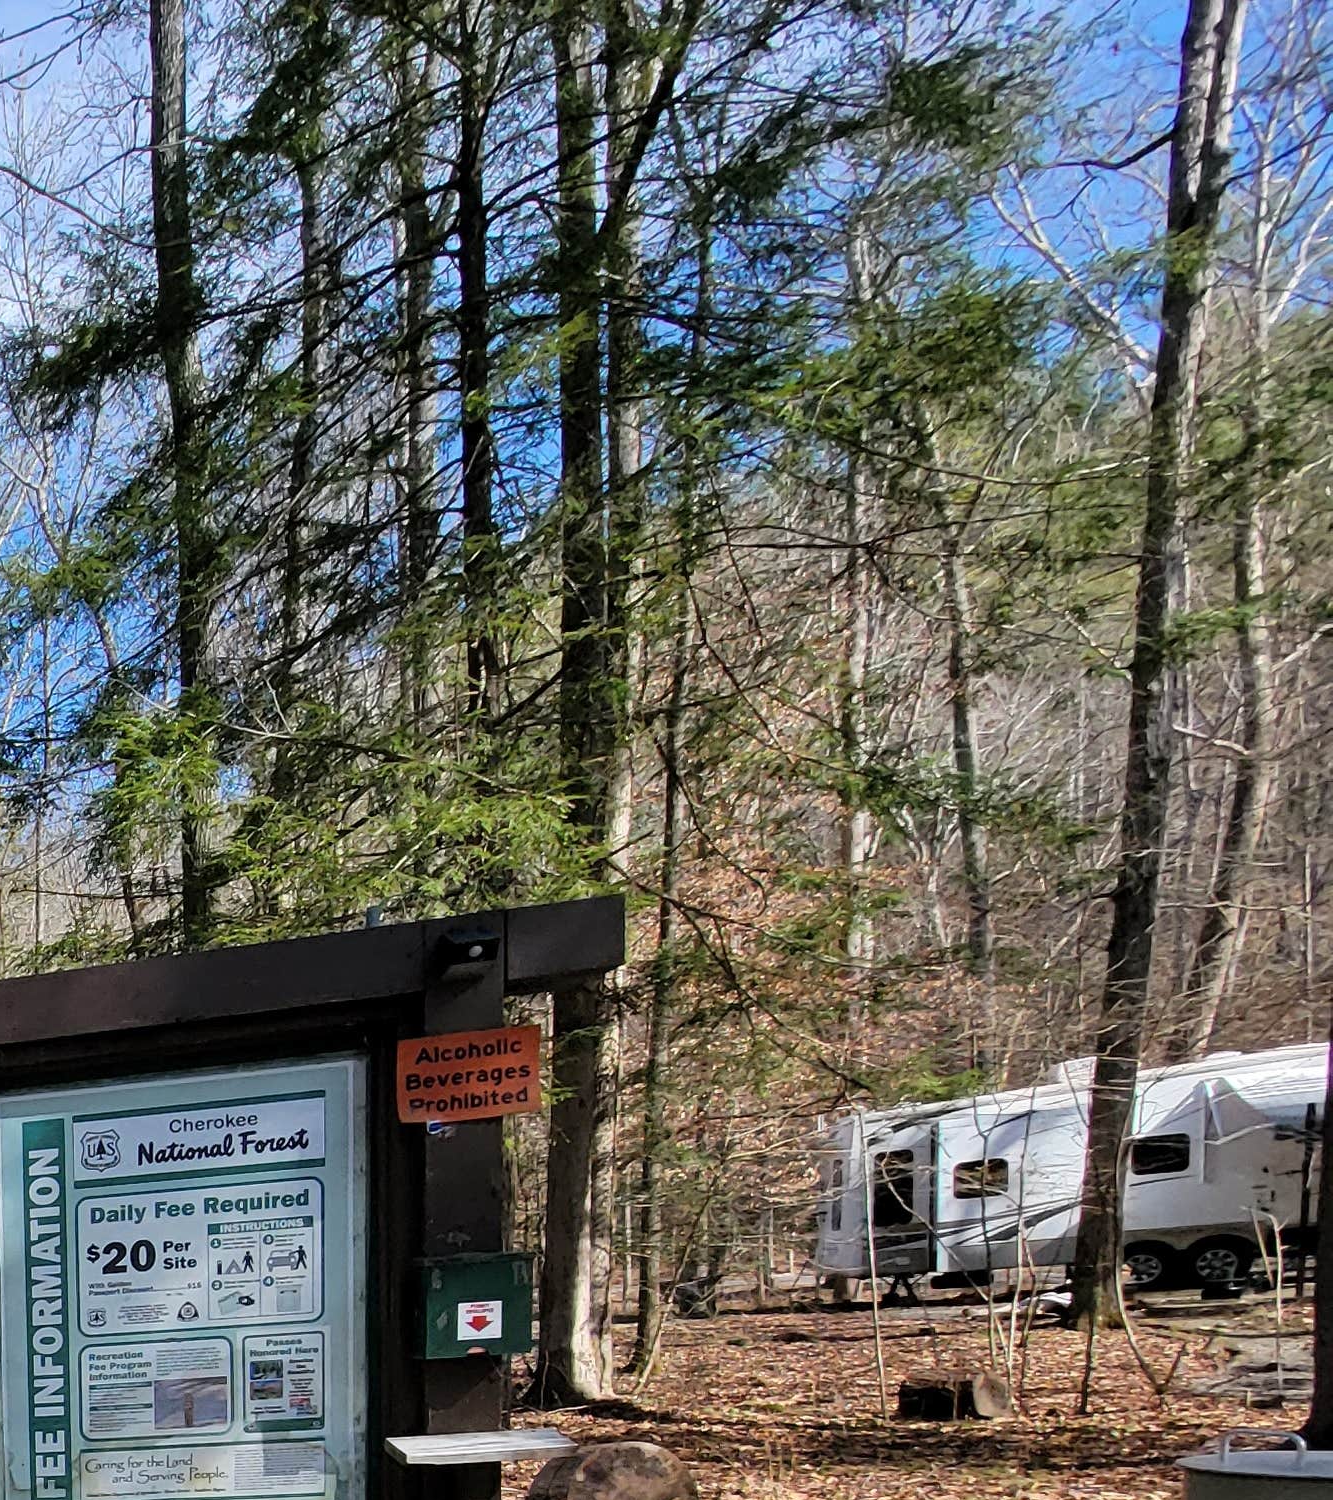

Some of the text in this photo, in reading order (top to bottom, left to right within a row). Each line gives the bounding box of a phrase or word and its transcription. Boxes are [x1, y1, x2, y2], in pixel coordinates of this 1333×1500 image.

[415, 1038, 522, 1064] Alcoholic
[405, 1065, 531, 1092] Beverages
[409, 1087, 528, 1114] Prohibited
[169, 1113, 258, 1134] Cherokee
[137, 1128, 309, 1166] National Forest
[90, 1188, 309, 1225] Daily Fee Required
[219, 1218, 304, 1233] INSTRUCTIONS
[86, 1239, 191, 1275] $20 Per
[163, 1255, 197, 1270] Site
[28, 1148, 67, 1498] FEE INFORMATION
[88, 1351, 143, 1361] Recreation
[88, 1361, 152, 1371] Fee Program
[89, 1371, 147, 1381] Information
[85, 1453, 193, 1473] Caring for the Land
[112, 1471, 133, 1484] and
[136, 1470, 185, 1484] Serving
